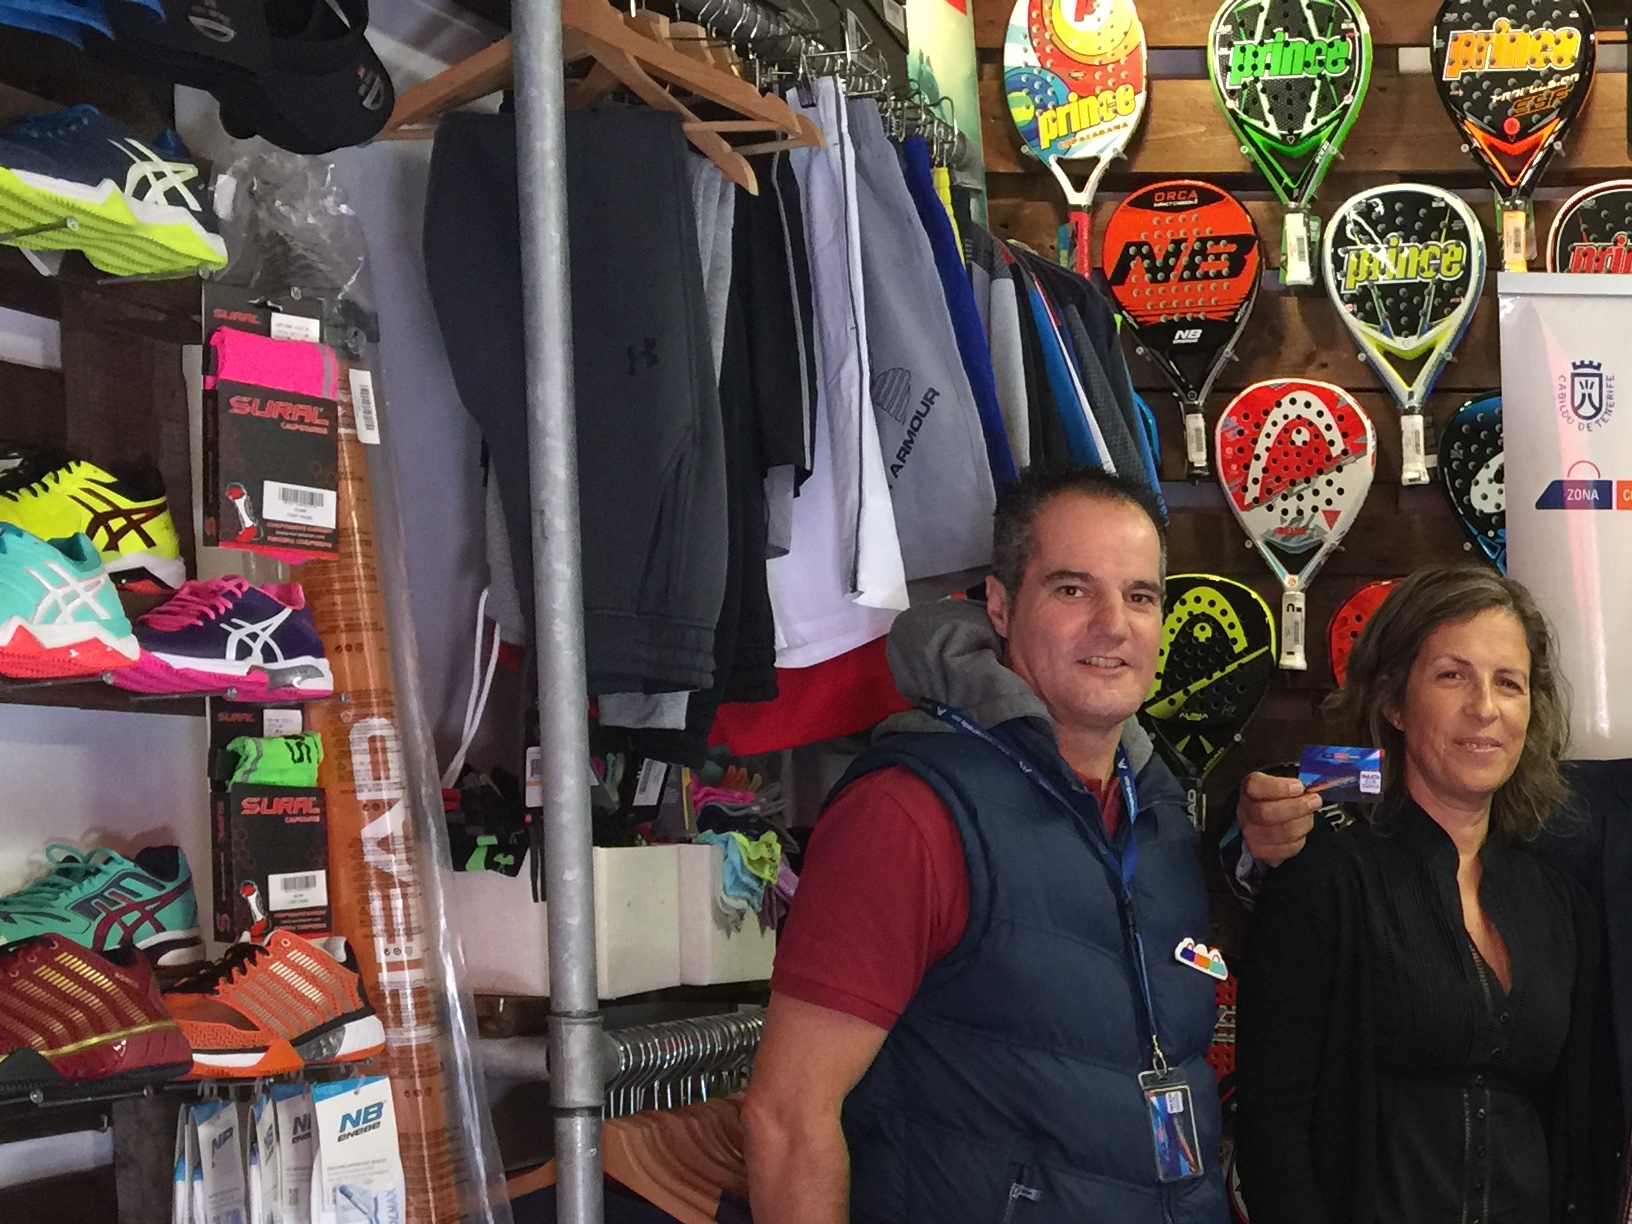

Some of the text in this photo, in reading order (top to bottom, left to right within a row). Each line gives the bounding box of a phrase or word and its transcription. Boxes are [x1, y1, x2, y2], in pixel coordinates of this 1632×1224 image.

[1228, 28, 1349, 89] prince
[1443, 17, 1582, 81] prince
[1037, 83, 1136, 149] prince
[1154, 189, 1198, 202] ORCA
[1108, 234, 1258, 286] NB
[1337, 232, 1466, 294] prince
[228, 395, 330, 426] SURAL
[1578, 421, 1593, 432] DE
[889, 386, 941, 480] ARMOUR
[1566, 488, 1600, 501] ZONA
[240, 796, 321, 815] SURAL
[338, 1101, 385, 1133] NB
